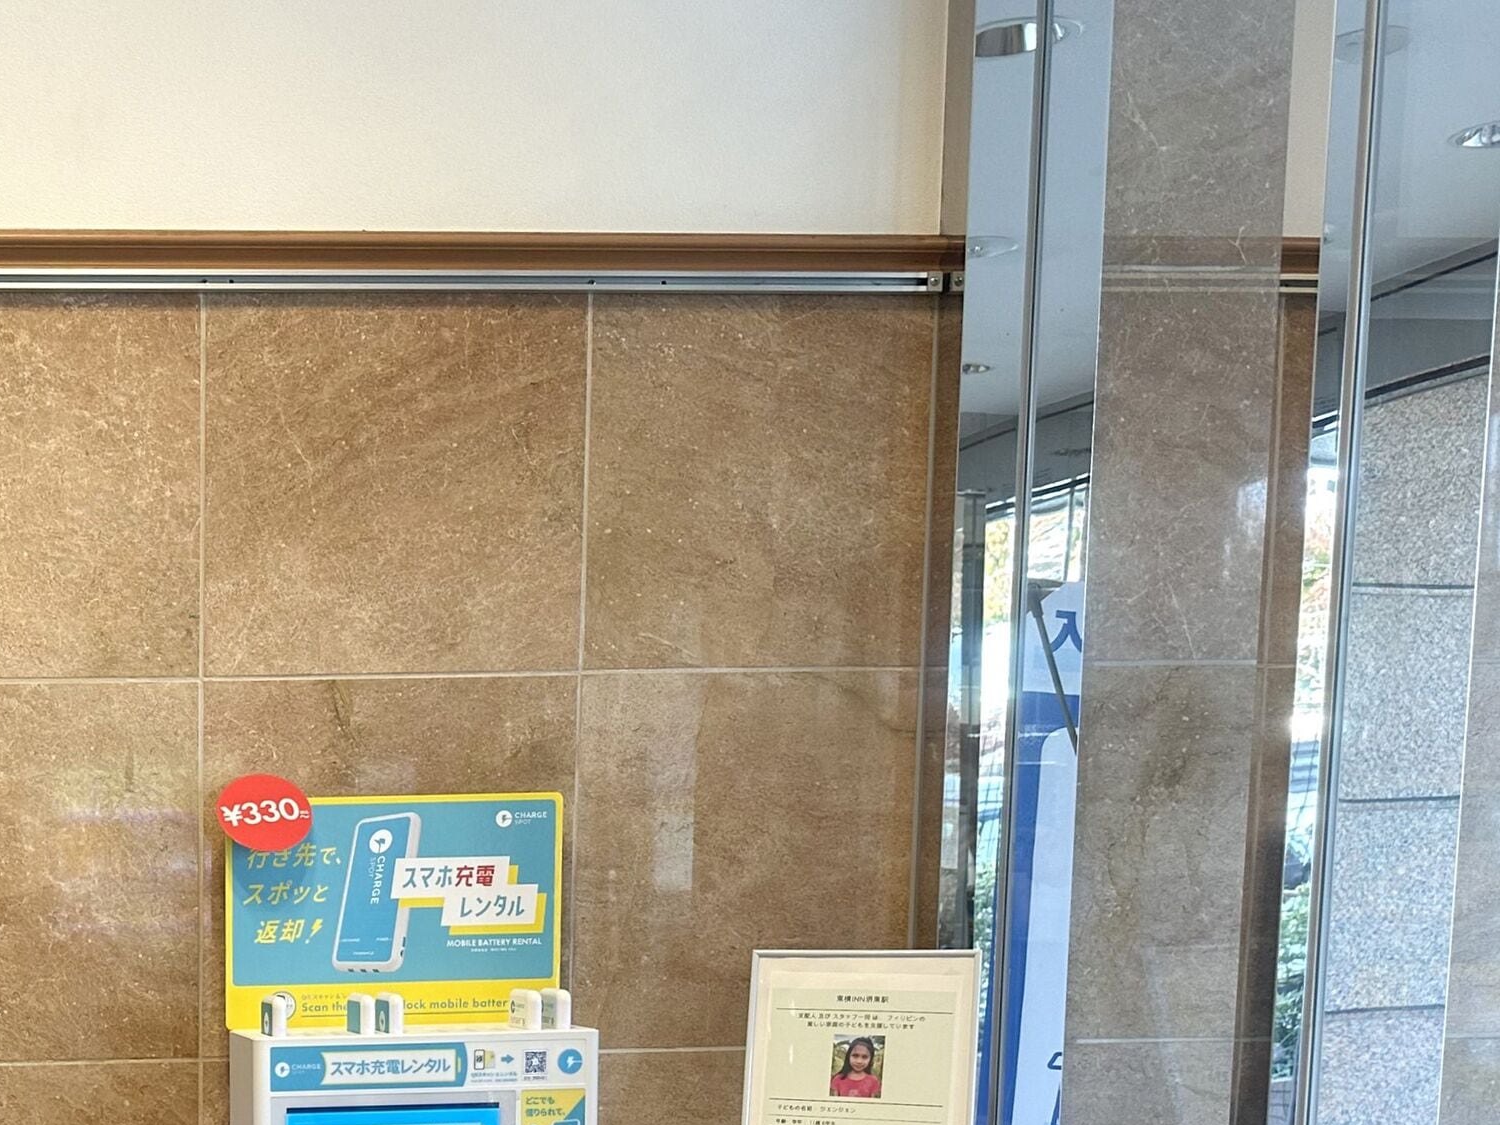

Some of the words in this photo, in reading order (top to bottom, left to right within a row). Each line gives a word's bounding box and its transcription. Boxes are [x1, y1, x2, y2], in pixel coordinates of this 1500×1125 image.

[514, 811, 547, 819] CHARGE
[370, 855, 386, 905] CHARGE
[402, 865, 495, 888] スマホ充電
[243, 880, 329, 905] スポッと
[460, 895, 525, 918] レンタル
[446, 939, 476, 948] MOBILE
[478, 938, 511, 947] BATTERY
[513, 937, 542, 946] RENTAL
[301, 1002, 329, 1012] Scan
[429, 998, 469, 1009] mobile
[472, 998, 509, 1008] batter
[330, 1057, 451, 1076] スマホ充電レンタル
[525, 1096, 555, 1105] どこでも
